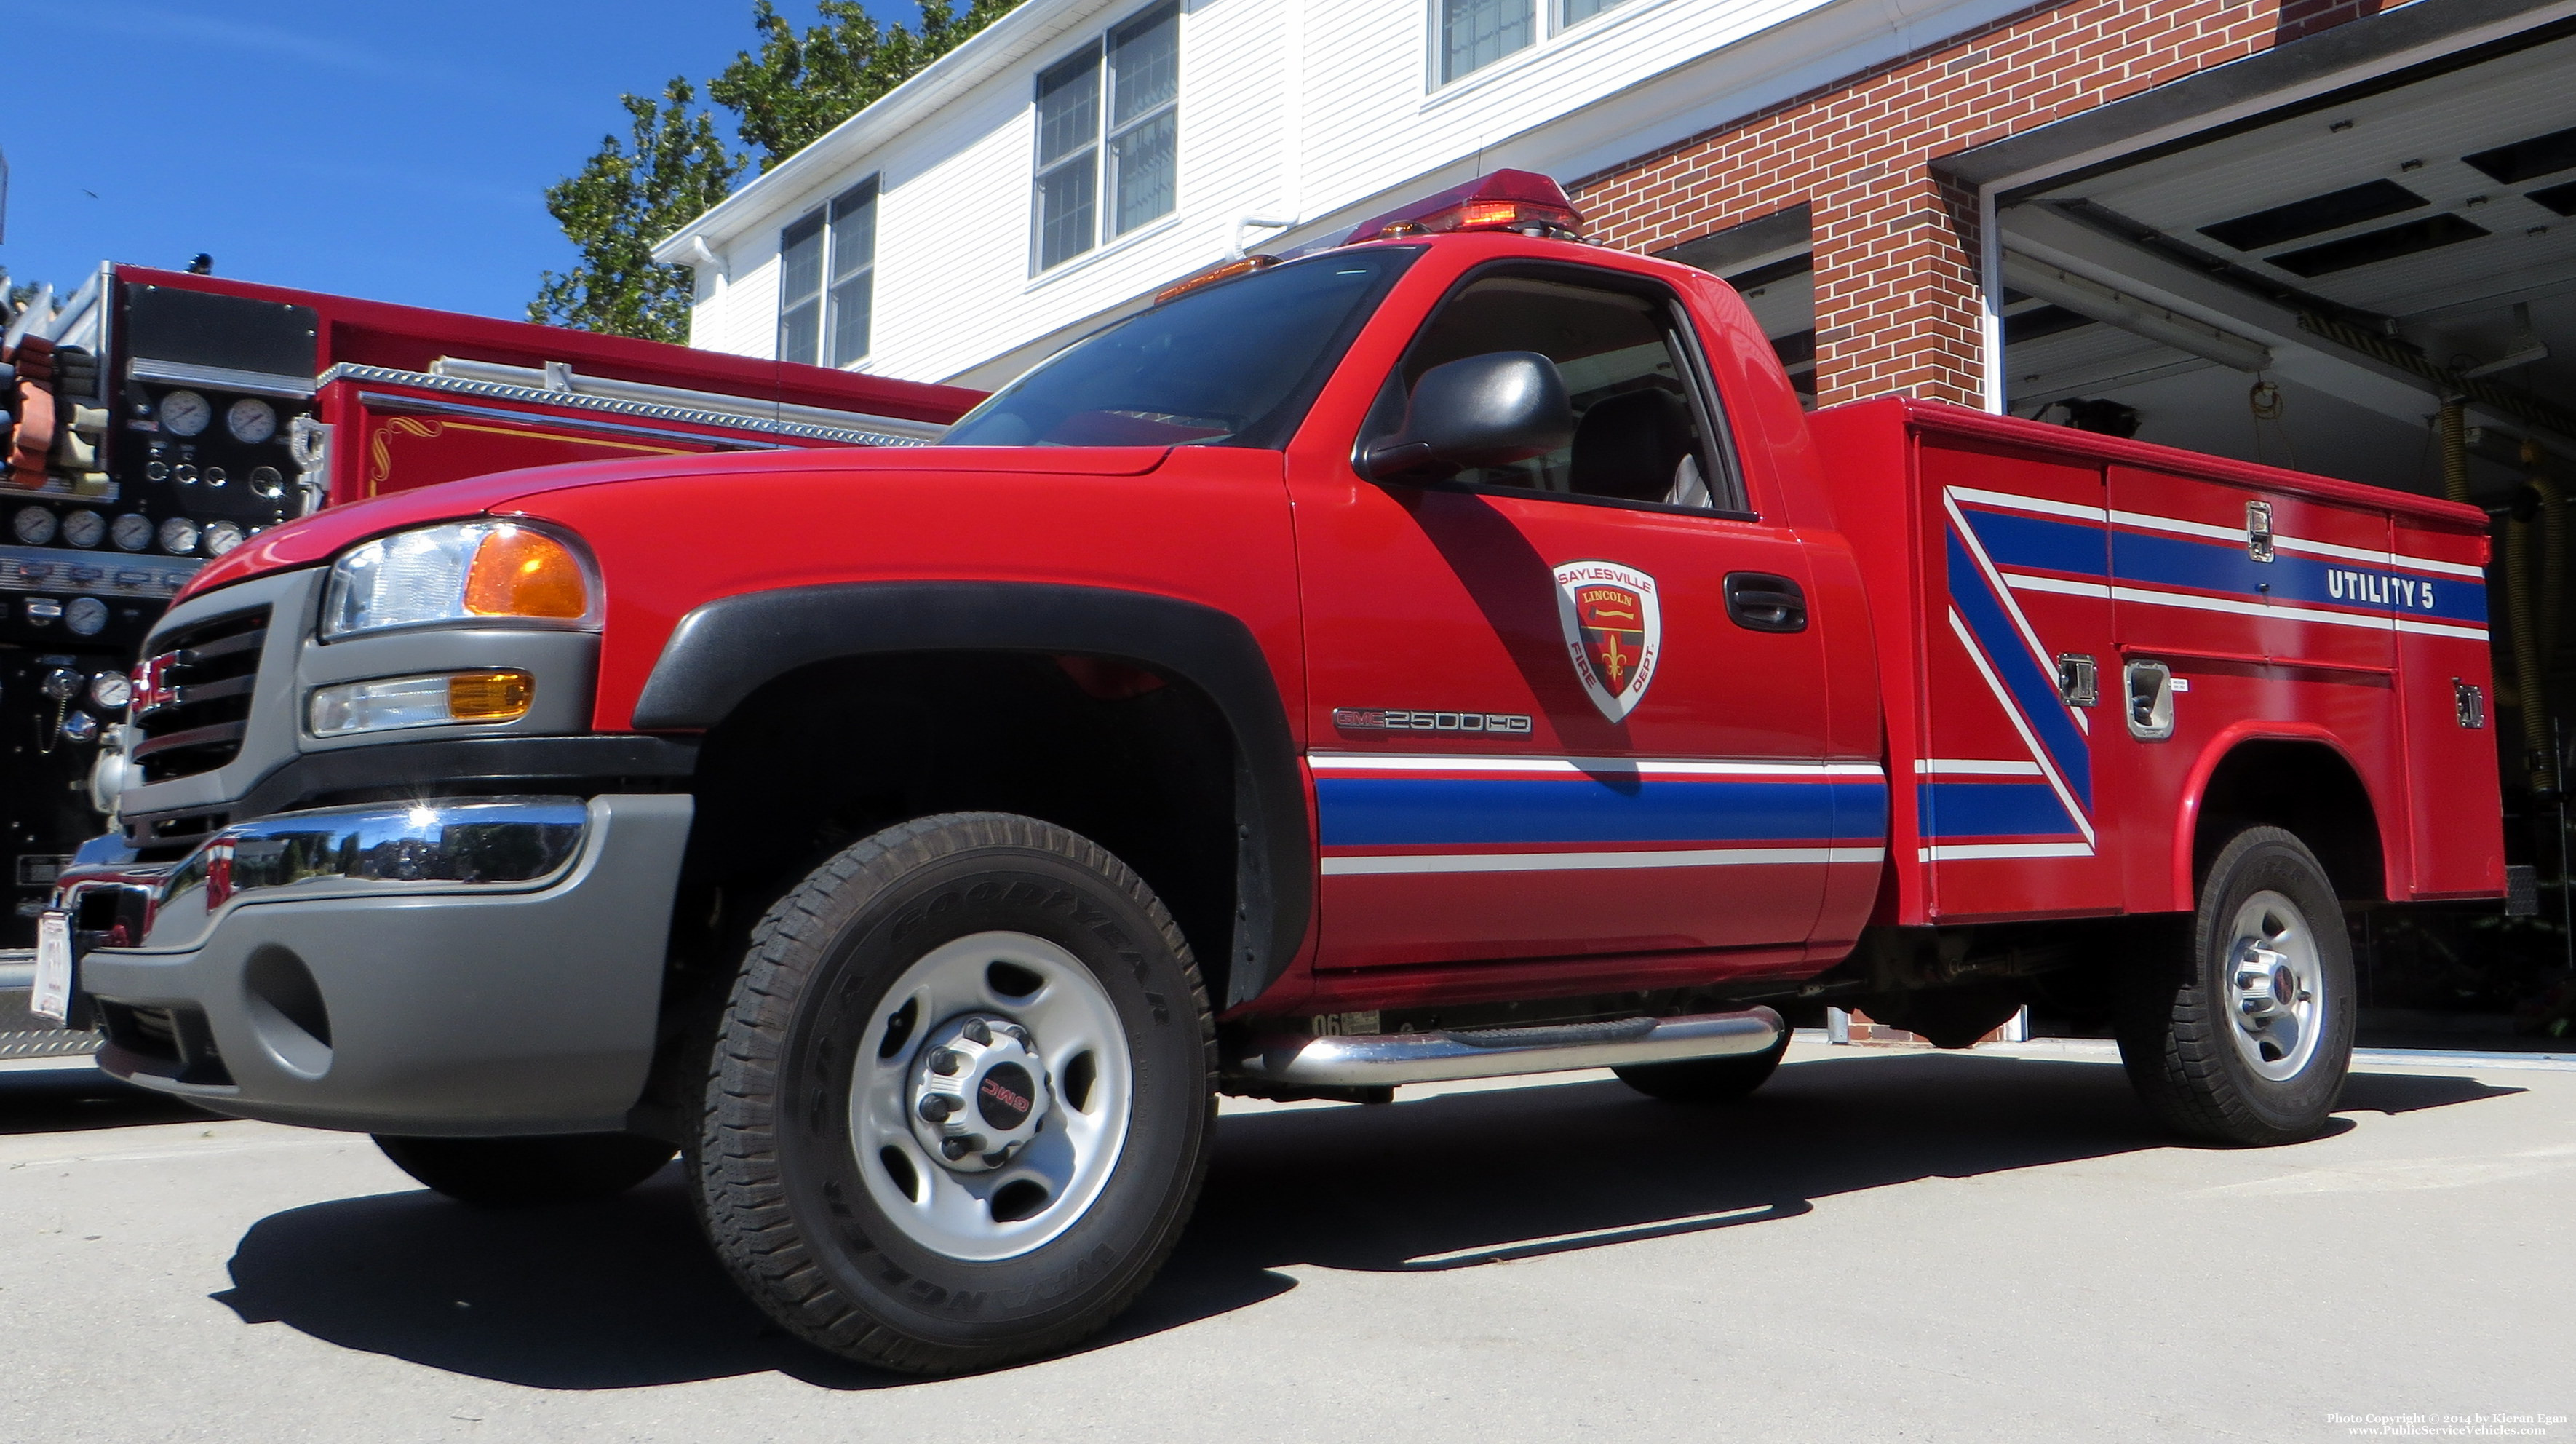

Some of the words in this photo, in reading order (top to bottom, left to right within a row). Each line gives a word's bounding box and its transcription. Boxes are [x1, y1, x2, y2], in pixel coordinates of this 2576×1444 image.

[1557, 568, 1652, 594] SAYLESVILLE
[2327, 568, 2415, 608] UTILITY
[2421, 582, 2434, 609] 5
[1582, 590, 1633, 606] LINCOLN
[1570, 640, 1597, 690] FIRE
[1632, 643, 1655, 694] DEPT.
[1336, 710, 1384, 726] GMC
[981, 1078, 1030, 1113] GMC
